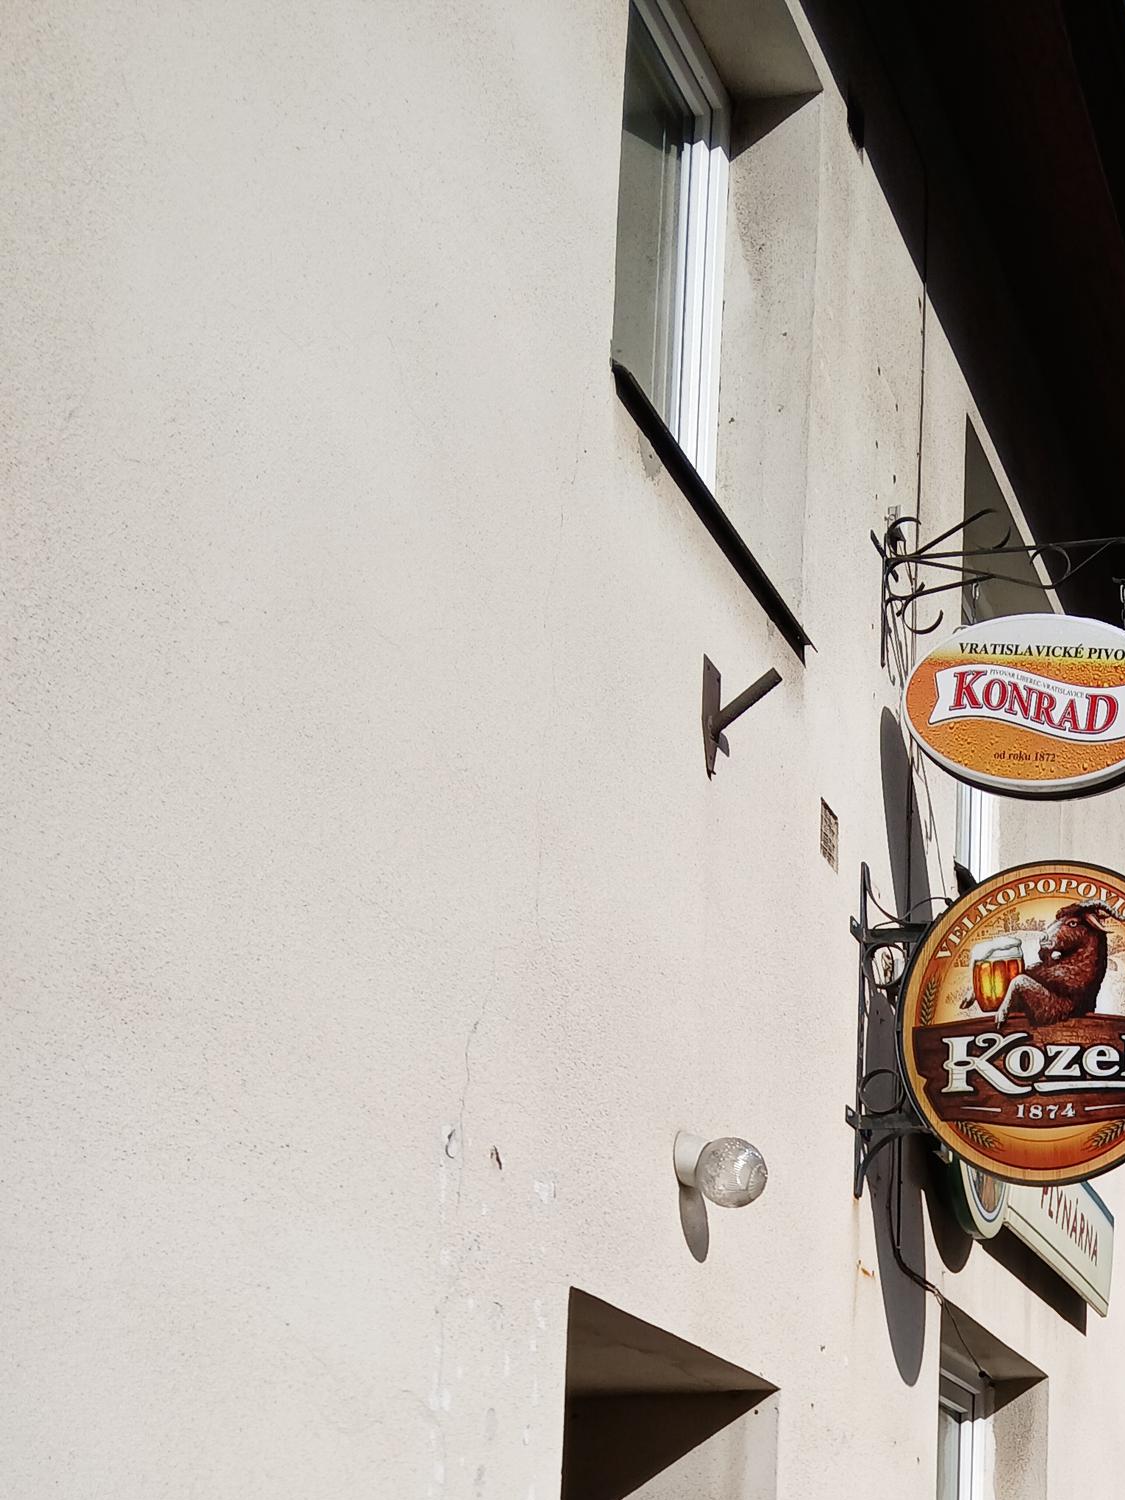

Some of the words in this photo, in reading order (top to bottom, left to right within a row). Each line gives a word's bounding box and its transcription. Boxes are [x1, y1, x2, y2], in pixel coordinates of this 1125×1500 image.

[959, 642, 1084, 659] VRATISLAVICKÉ
[948, 669, 1119, 734] KONRAD
[993, 751, 1006, 760] od
[1008, 751, 1031, 761] roku
[1034, 752, 1056, 762] 1872
[1015, 1103, 1077, 1119] 1874
